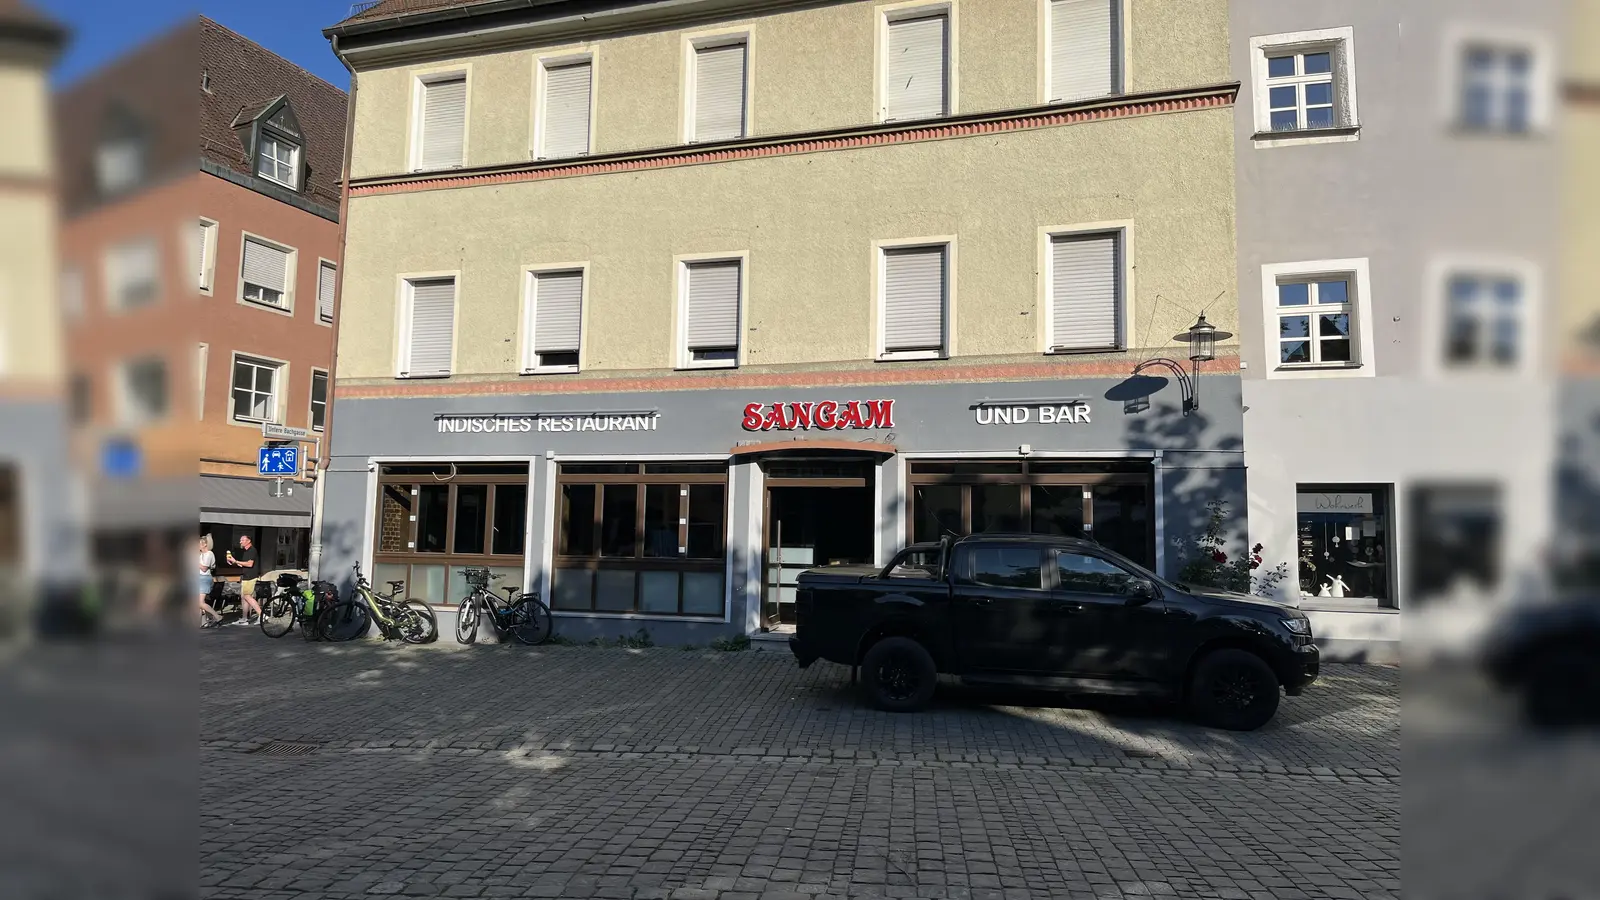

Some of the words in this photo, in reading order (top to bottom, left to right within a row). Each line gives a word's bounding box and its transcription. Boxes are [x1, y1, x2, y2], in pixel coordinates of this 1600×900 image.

[437, 416, 532, 433] INDISCHES
[537, 413, 661, 432] RESTAURANT
[742, 399, 896, 431] SANGAM
[976, 406, 1030, 425] UND
[1038, 404, 1092, 424] BAR
